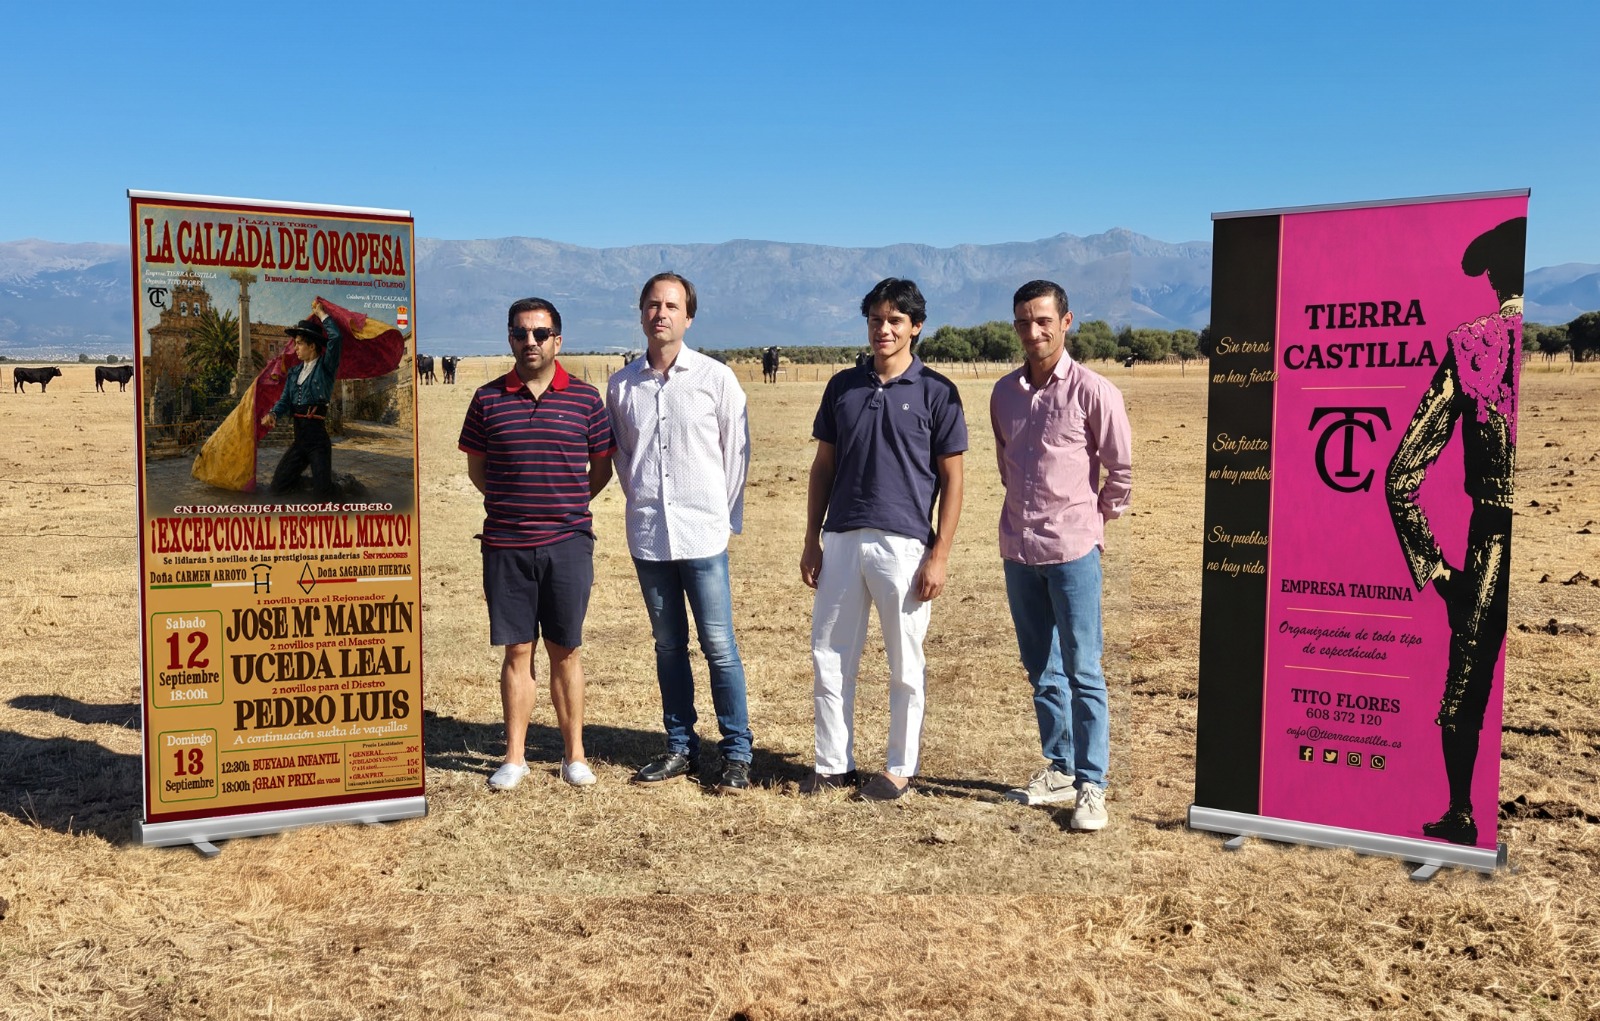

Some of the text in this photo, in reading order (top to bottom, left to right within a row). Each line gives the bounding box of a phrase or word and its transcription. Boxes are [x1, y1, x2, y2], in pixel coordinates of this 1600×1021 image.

[144, 218, 406, 276] LA CALZADA DE OROPESA
[1283, 299, 1438, 370] TIERRA CASTILLA
[1216, 337, 1271, 355] Sin toros
[1212, 368, 1279, 388] no hay fiesta
[1213, 432, 1269, 455] Sin fiesta
[1209, 465, 1272, 484] no hay pueblos
[174, 505, 193, 514] EN
[196, 504, 272, 514] HOMENAJE
[285, 502, 340, 512] NICOLÁS
[342, 503, 393, 512] CUBERO
[151, 514, 412, 554] ¡EXCEPCIONAL FESTIVAL MIXTO!
[1207, 525, 1268, 548] Sin pueblos
[274, 552, 318, 562] prestigiosas
[320, 552, 360, 562] ganaderías
[150, 568, 247, 584] Doña CARMEN ARROYO
[318, 564, 411, 578] Doña SAGRARIO HUERTAS
[1207, 558, 1265, 578] no hay vida
[263, 597, 296, 605] novillo
[298, 597, 320, 606] para
[332, 594, 386, 604] Rejoneador
[1281, 579, 1413, 601] EMPRESA TAURINA
[166, 617, 206, 630] Sabado
[226, 606, 289, 642] JOSE
[324, 595, 414, 636] MARTÍN
[1279, 620, 1422, 646] Organización de todo tipo
[166, 631, 209, 670] 12
[277, 640, 314, 650] novillos
[315, 640, 337, 650] para
[338, 638, 347, 647] el
[348, 637, 386, 646] Maestro
[1303, 643, 1387, 660] de espectáculos
[230, 646, 411, 684] UCEDA LEAL
[159, 670, 220, 689] Septiembre
[279, 683, 316, 694] novillos
[318, 684, 340, 694] para
[341, 681, 350, 690] el
[352, 680, 385, 690] Diestro
[170, 690, 208, 701] 18:00h
[1291, 688, 1400, 713] TITO FLORES
[233, 689, 410, 731] PEDRO LUIS
[1306, 708, 1382, 726] 608 372 120
[166, 733, 212, 747] Domingo
[233, 722, 408, 745] A continuación suelta de vaquillas
[173, 748, 204, 776] 13
[221, 752, 341, 774] 12:30h BUEYADA INFANTIL
[165, 777, 214, 793] Septiembre
[222, 779, 250, 793] 18:00h
[252, 775, 286, 793] ¡GRAN
[288, 773, 316, 787] PRIX!
